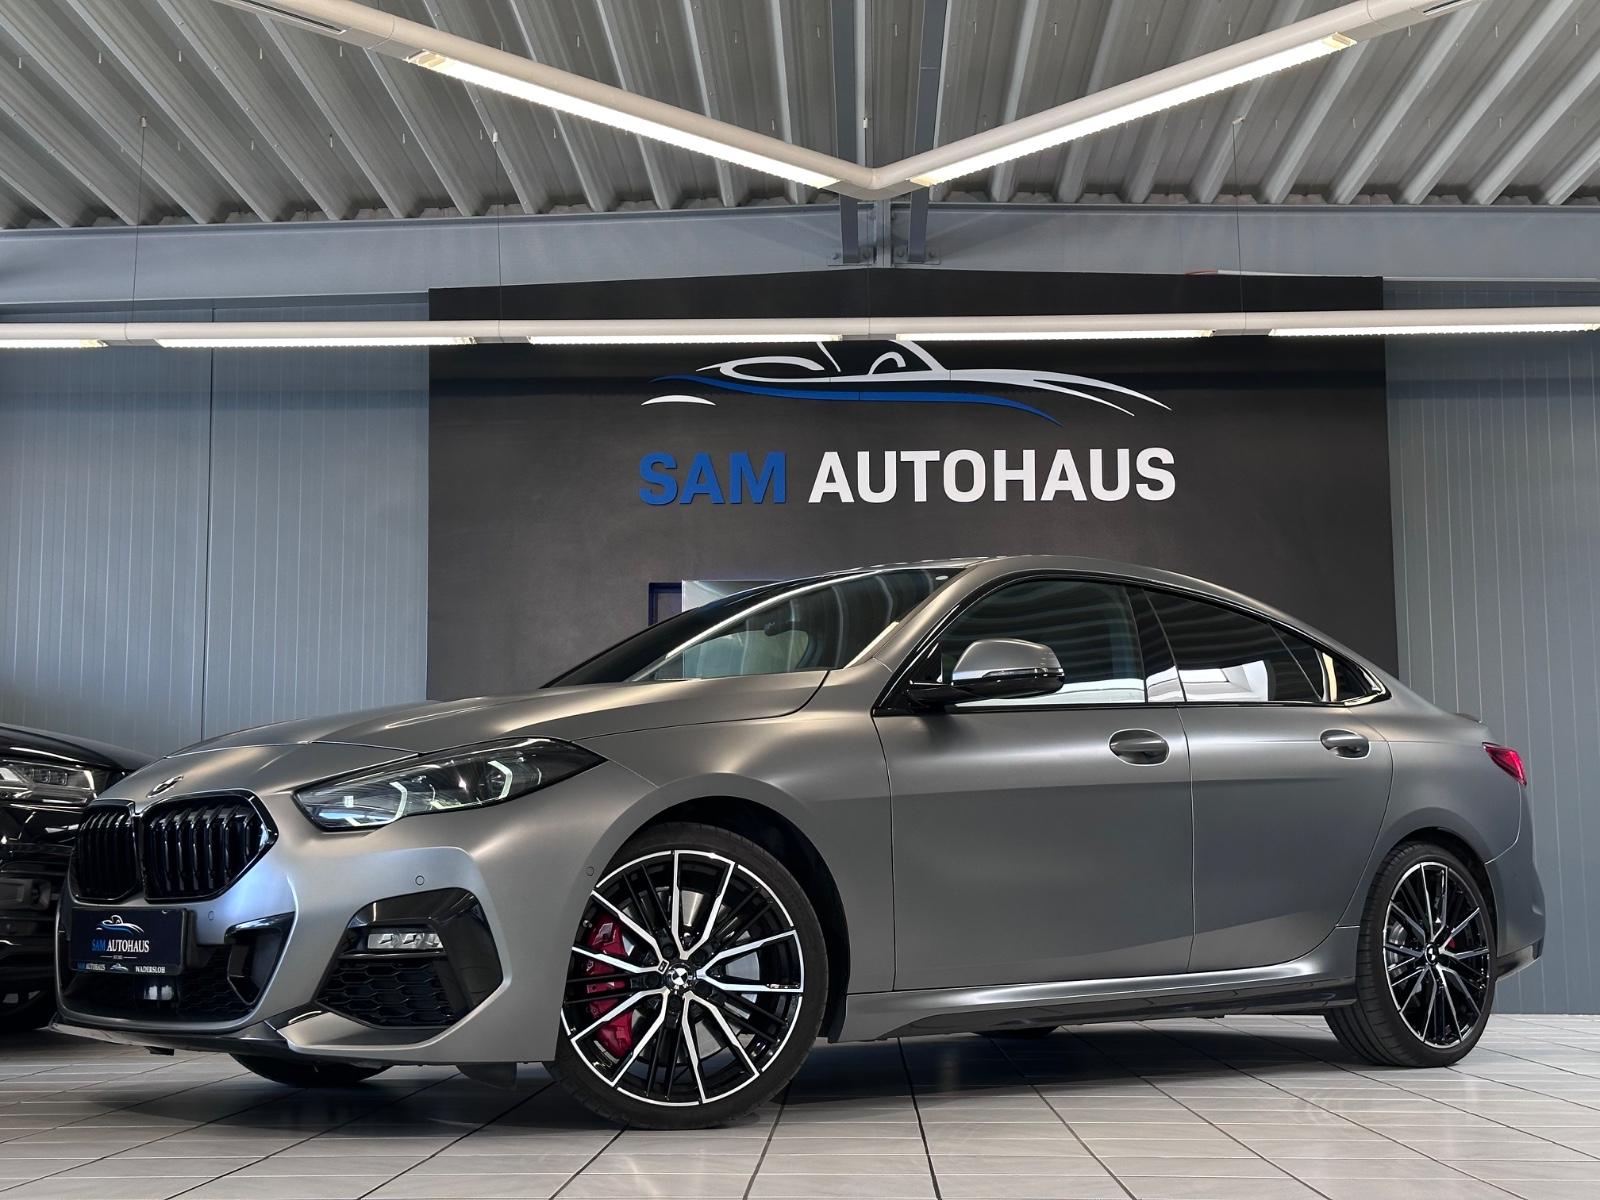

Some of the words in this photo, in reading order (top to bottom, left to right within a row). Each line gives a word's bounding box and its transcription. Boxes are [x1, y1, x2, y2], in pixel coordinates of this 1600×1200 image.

[638, 451, 787, 505] SAM
[808, 447, 1177, 503] AUTOHAUS
[91, 939, 106, 952] SAM
[106, 939, 150, 953] AUTOHAUS
[135, 965, 166, 974] WADERSLOH
